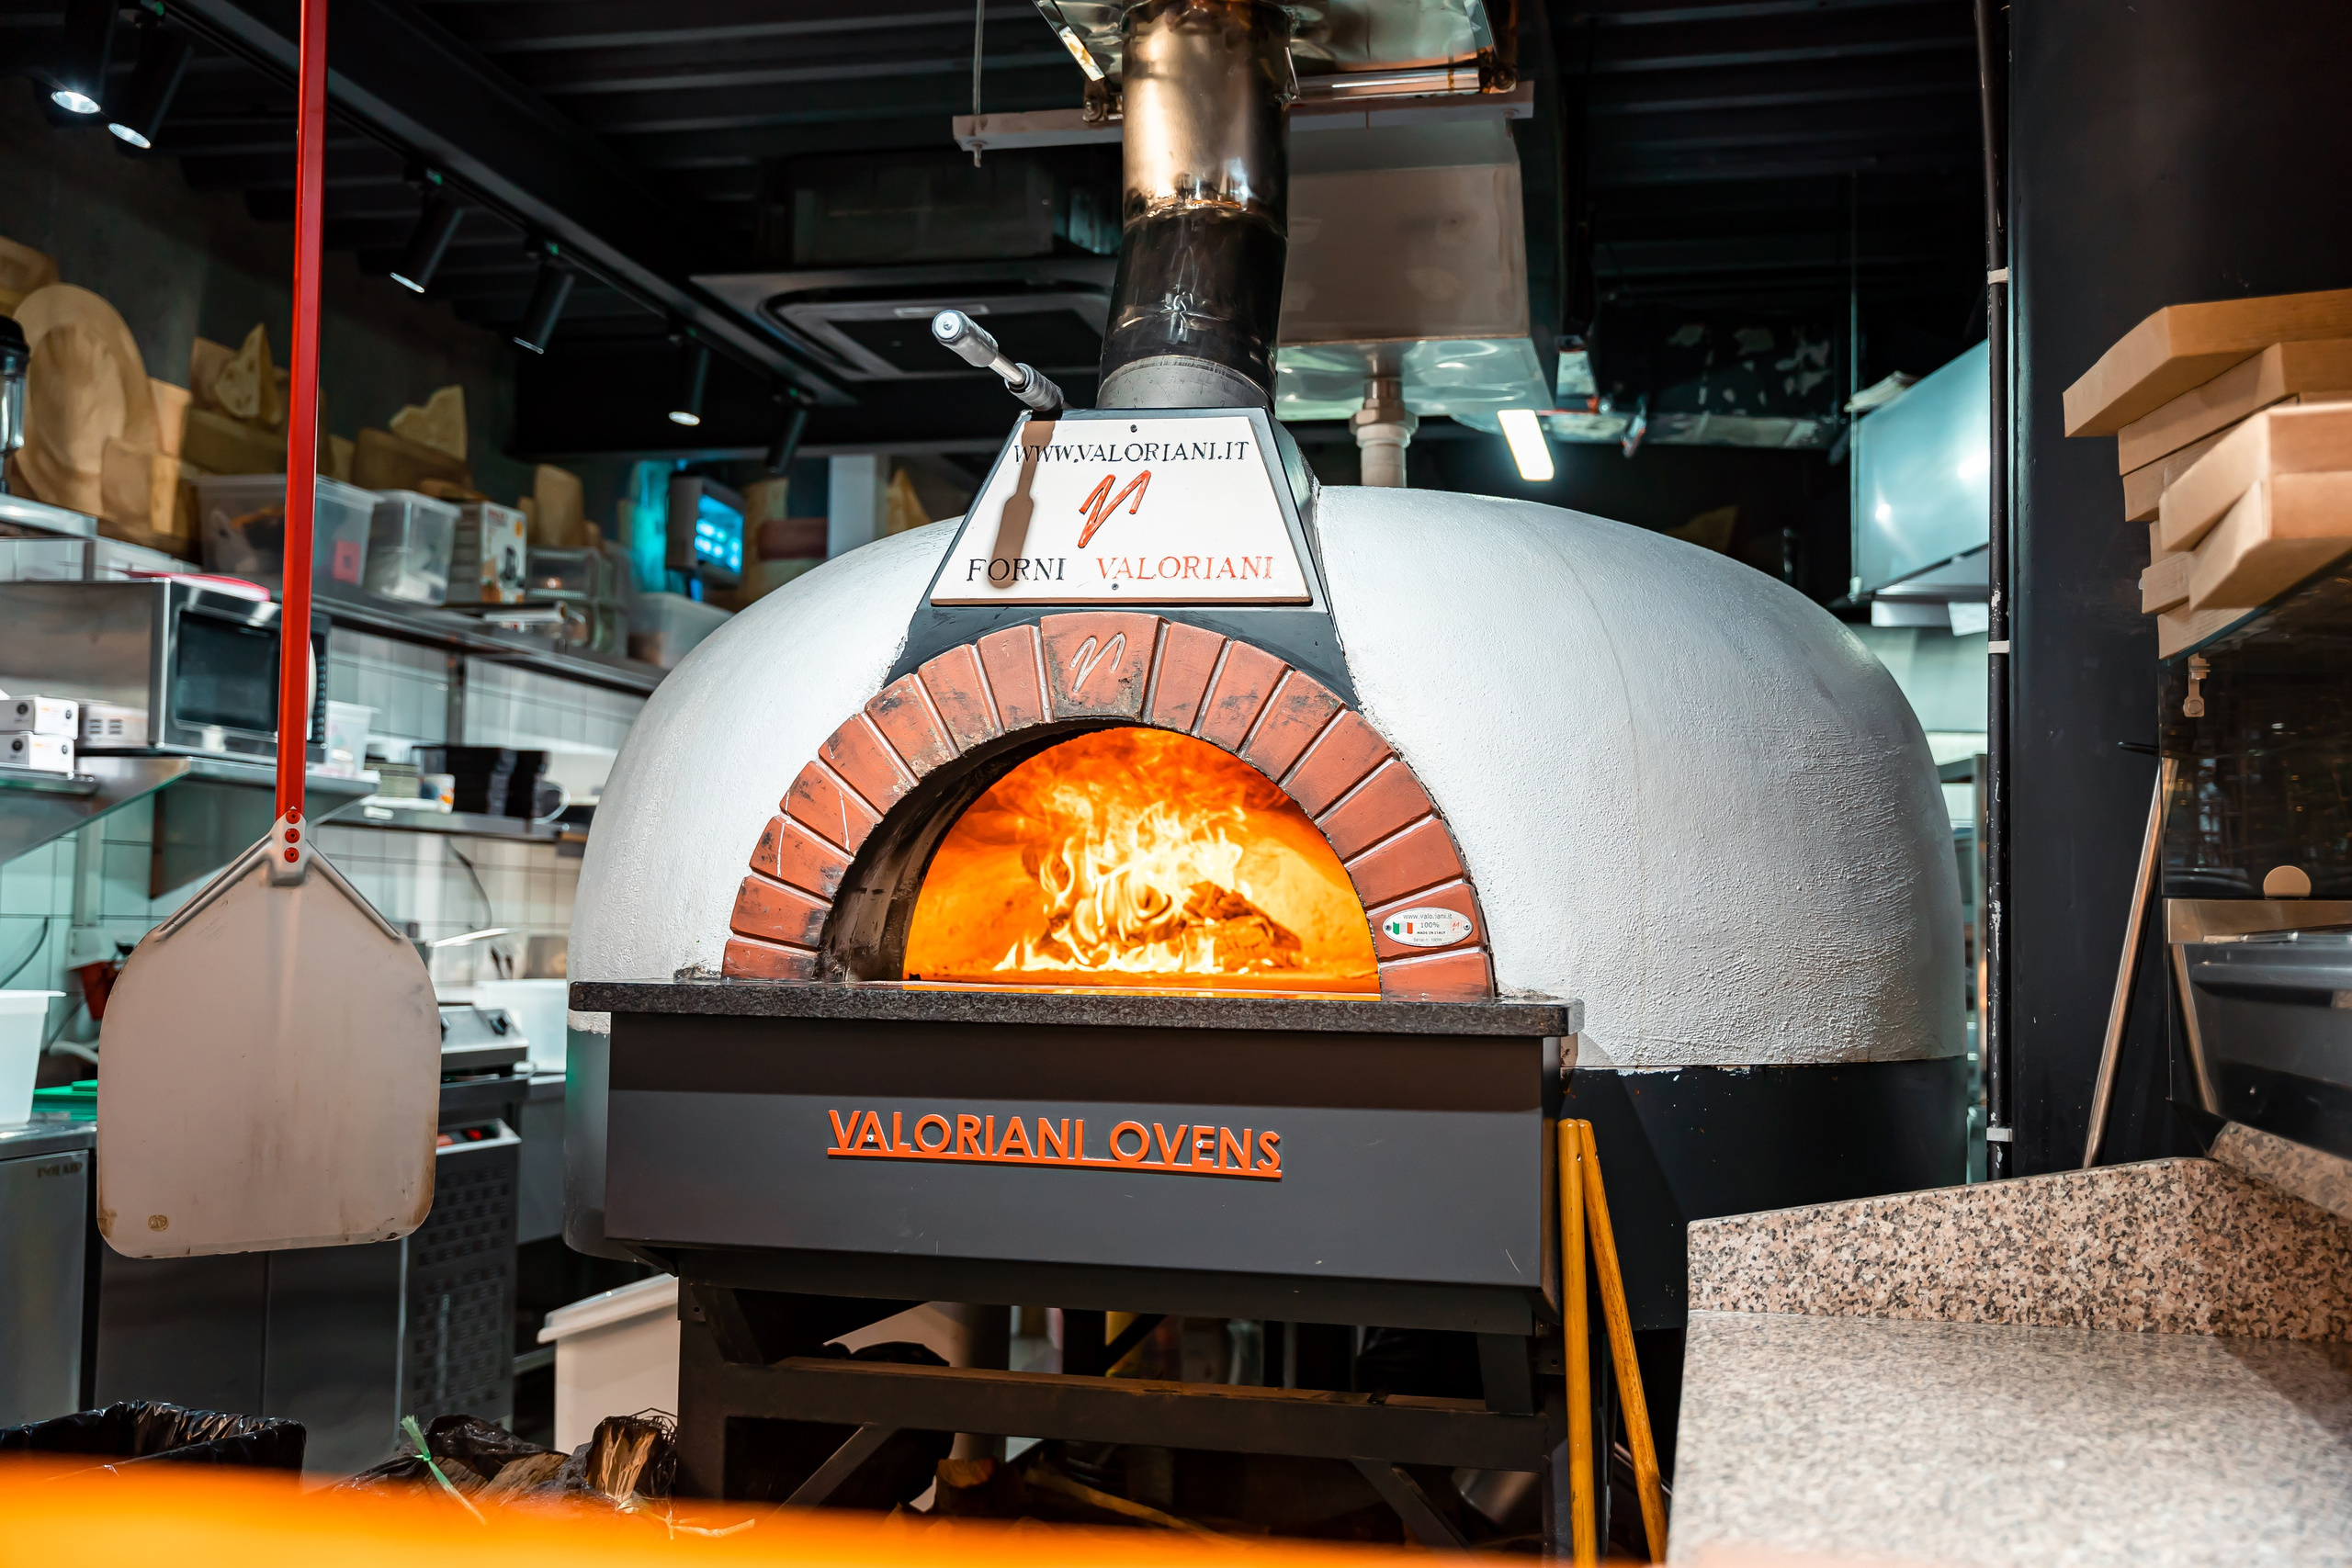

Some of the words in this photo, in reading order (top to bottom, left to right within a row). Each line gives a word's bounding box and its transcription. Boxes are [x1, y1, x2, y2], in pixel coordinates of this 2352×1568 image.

[1013, 441, 1250, 464] WWW.VALORIANI.IT
[966, 557, 1068, 582] FORNI
[1095, 555, 1274, 581] VALORIANI
[828, 1109, 1085, 1161] VALORIANI
[1108, 1120, 1282, 1172] OVENS
